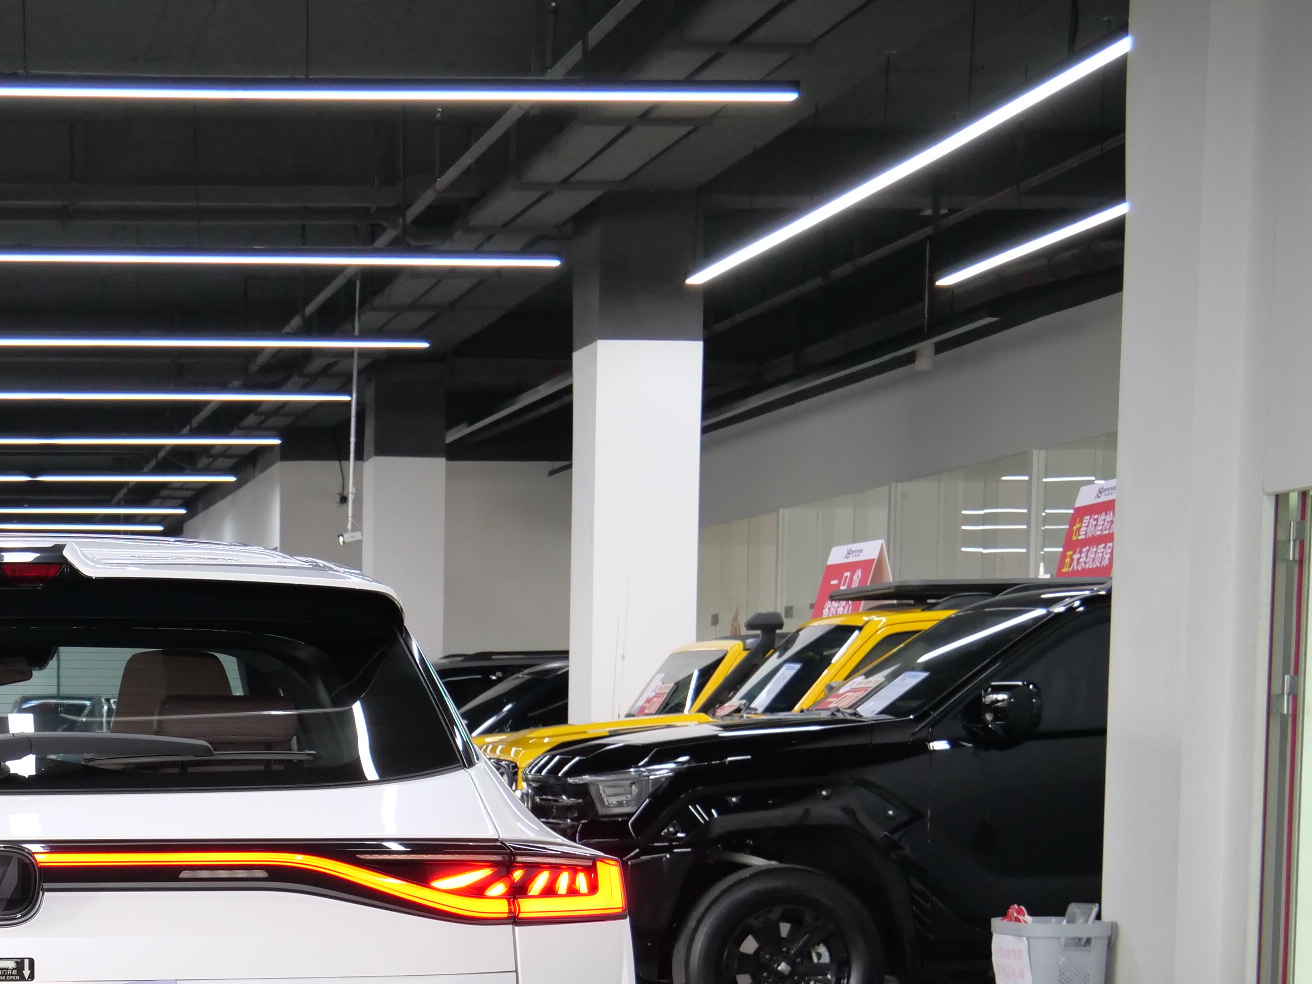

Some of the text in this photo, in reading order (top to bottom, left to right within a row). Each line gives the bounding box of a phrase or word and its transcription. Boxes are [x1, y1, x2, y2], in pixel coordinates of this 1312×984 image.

[1071, 510, 1116, 541] 七星标准检
[1061, 542, 1113, 573] 五大系统质保
[830, 568, 862, 590] 一口价
